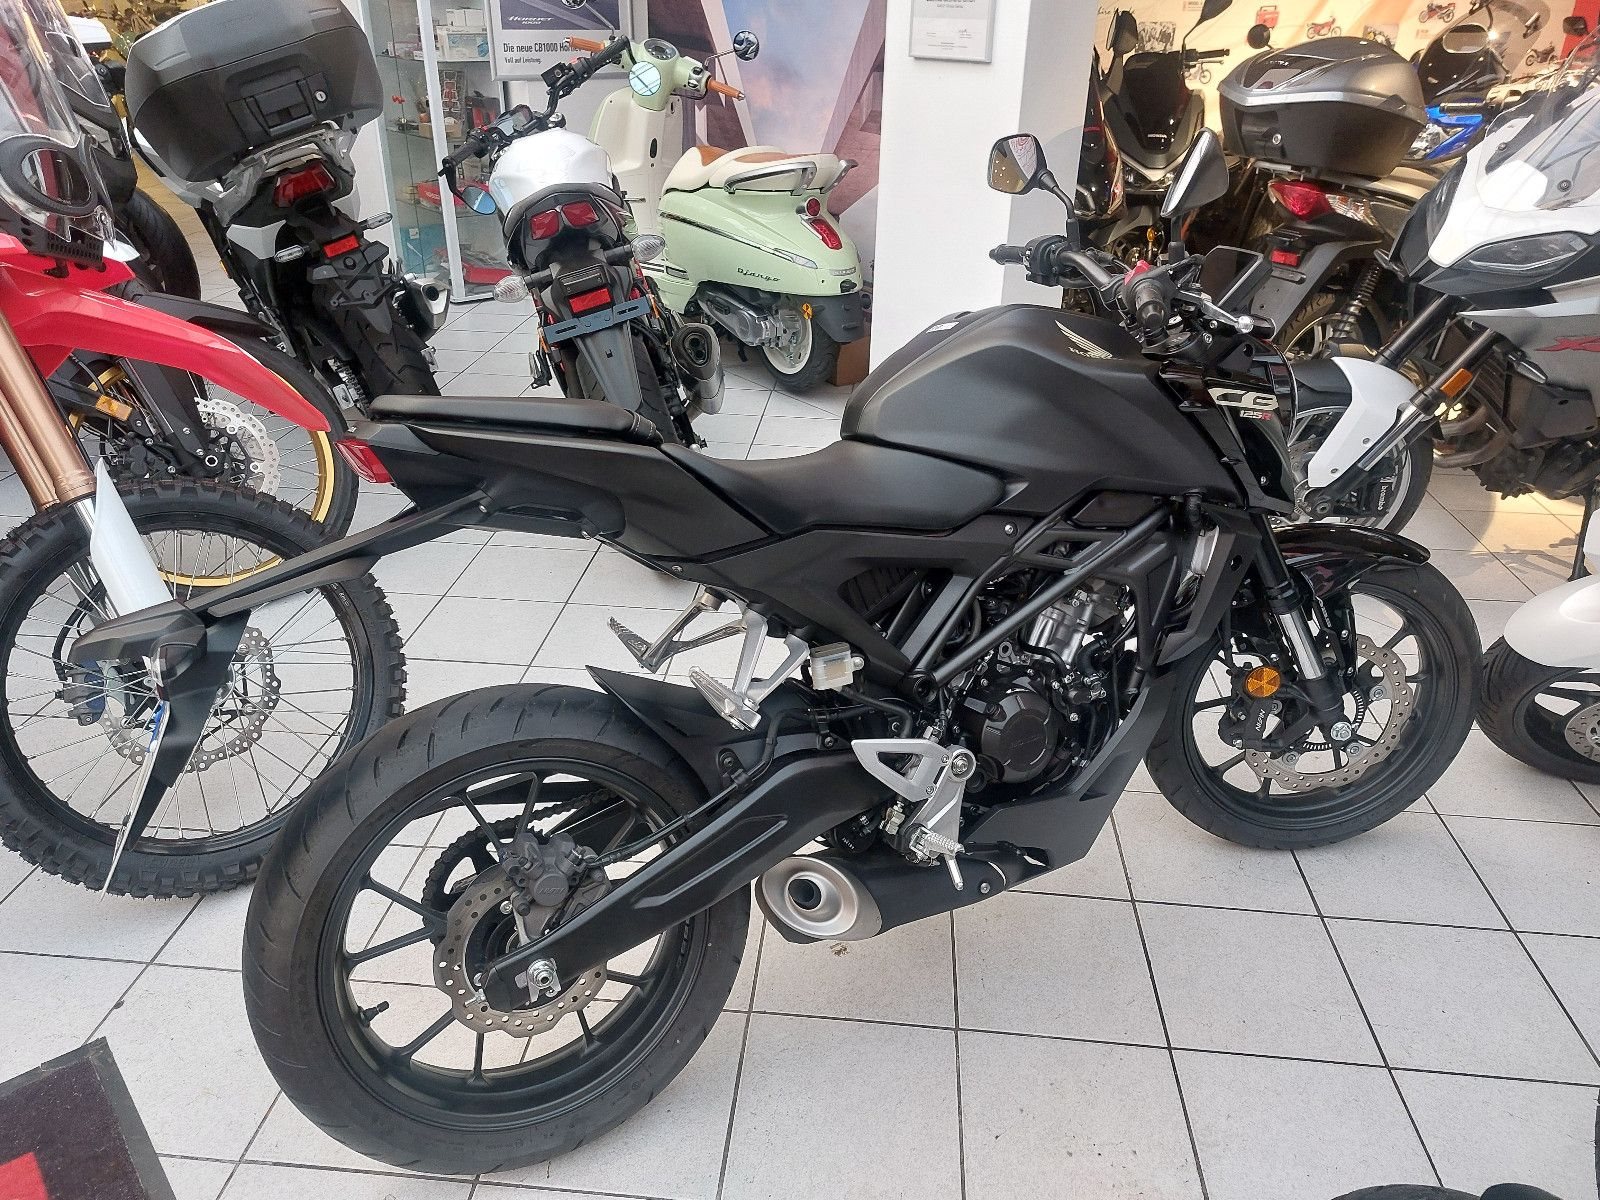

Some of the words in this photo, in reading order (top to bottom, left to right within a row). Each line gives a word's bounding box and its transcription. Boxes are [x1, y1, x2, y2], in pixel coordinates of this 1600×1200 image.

[503, 43, 515, 52] Die
[534, 43, 558, 52] CB1000
[1207, 387, 1280, 411] CB
[1240, 410, 1273, 421] 125R
[1377, 485, 1389, 511] brembo
[1255, 708, 1266, 732] NISSIN
